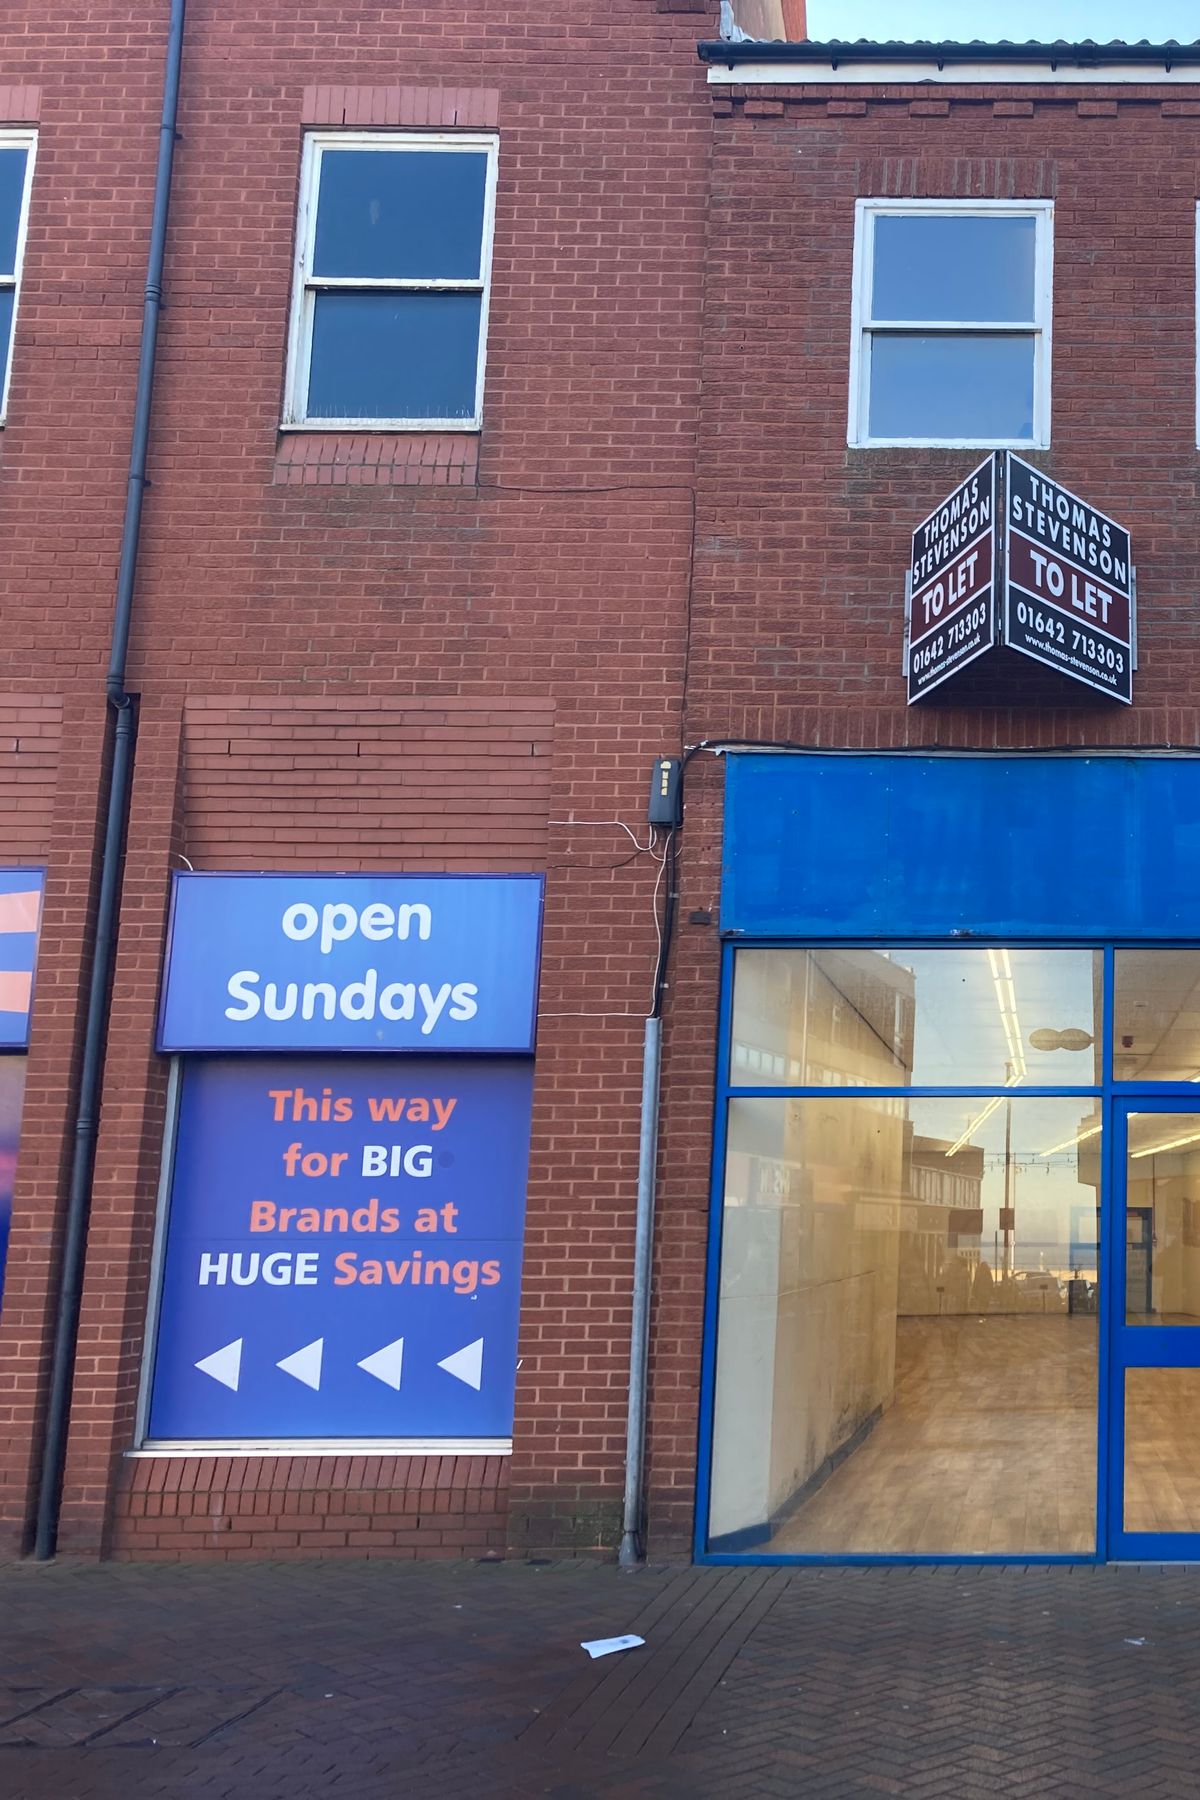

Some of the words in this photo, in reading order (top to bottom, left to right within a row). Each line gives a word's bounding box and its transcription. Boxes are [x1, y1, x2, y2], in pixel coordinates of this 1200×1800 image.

[913, 496, 990, 585] STEVENSON
[924, 477, 979, 548] THOMAS
[1013, 495, 1127, 584] STEVENSON
[1030, 475, 1111, 548] THOMAS
[922, 582, 944, 624] TO
[948, 551, 979, 605] LET
[1030, 550, 1065, 597] TO
[1072, 574, 1113, 624] LET
[913, 635, 944, 674] 01642
[948, 602, 987, 649] 713303
[1017, 602, 1065, 644] 01642
[1072, 631, 1124, 674] 713303
[1025, 633, 1118, 686] www.thomas-stevenson.co.uk
[282, 902, 432, 954] open
[224, 968, 479, 1034] Sundays
[269, 1089, 353, 1122] This
[368, 1095, 457, 1131] way
[283, 1144, 348, 1177] for
[361, 1144, 433, 1178] BIG
[249, 1199, 400, 1233] Brands
[414, 1204, 458, 1233] at
[198, 1252, 319, 1286] HUGE
[333, 1251, 501, 1294] Savings
